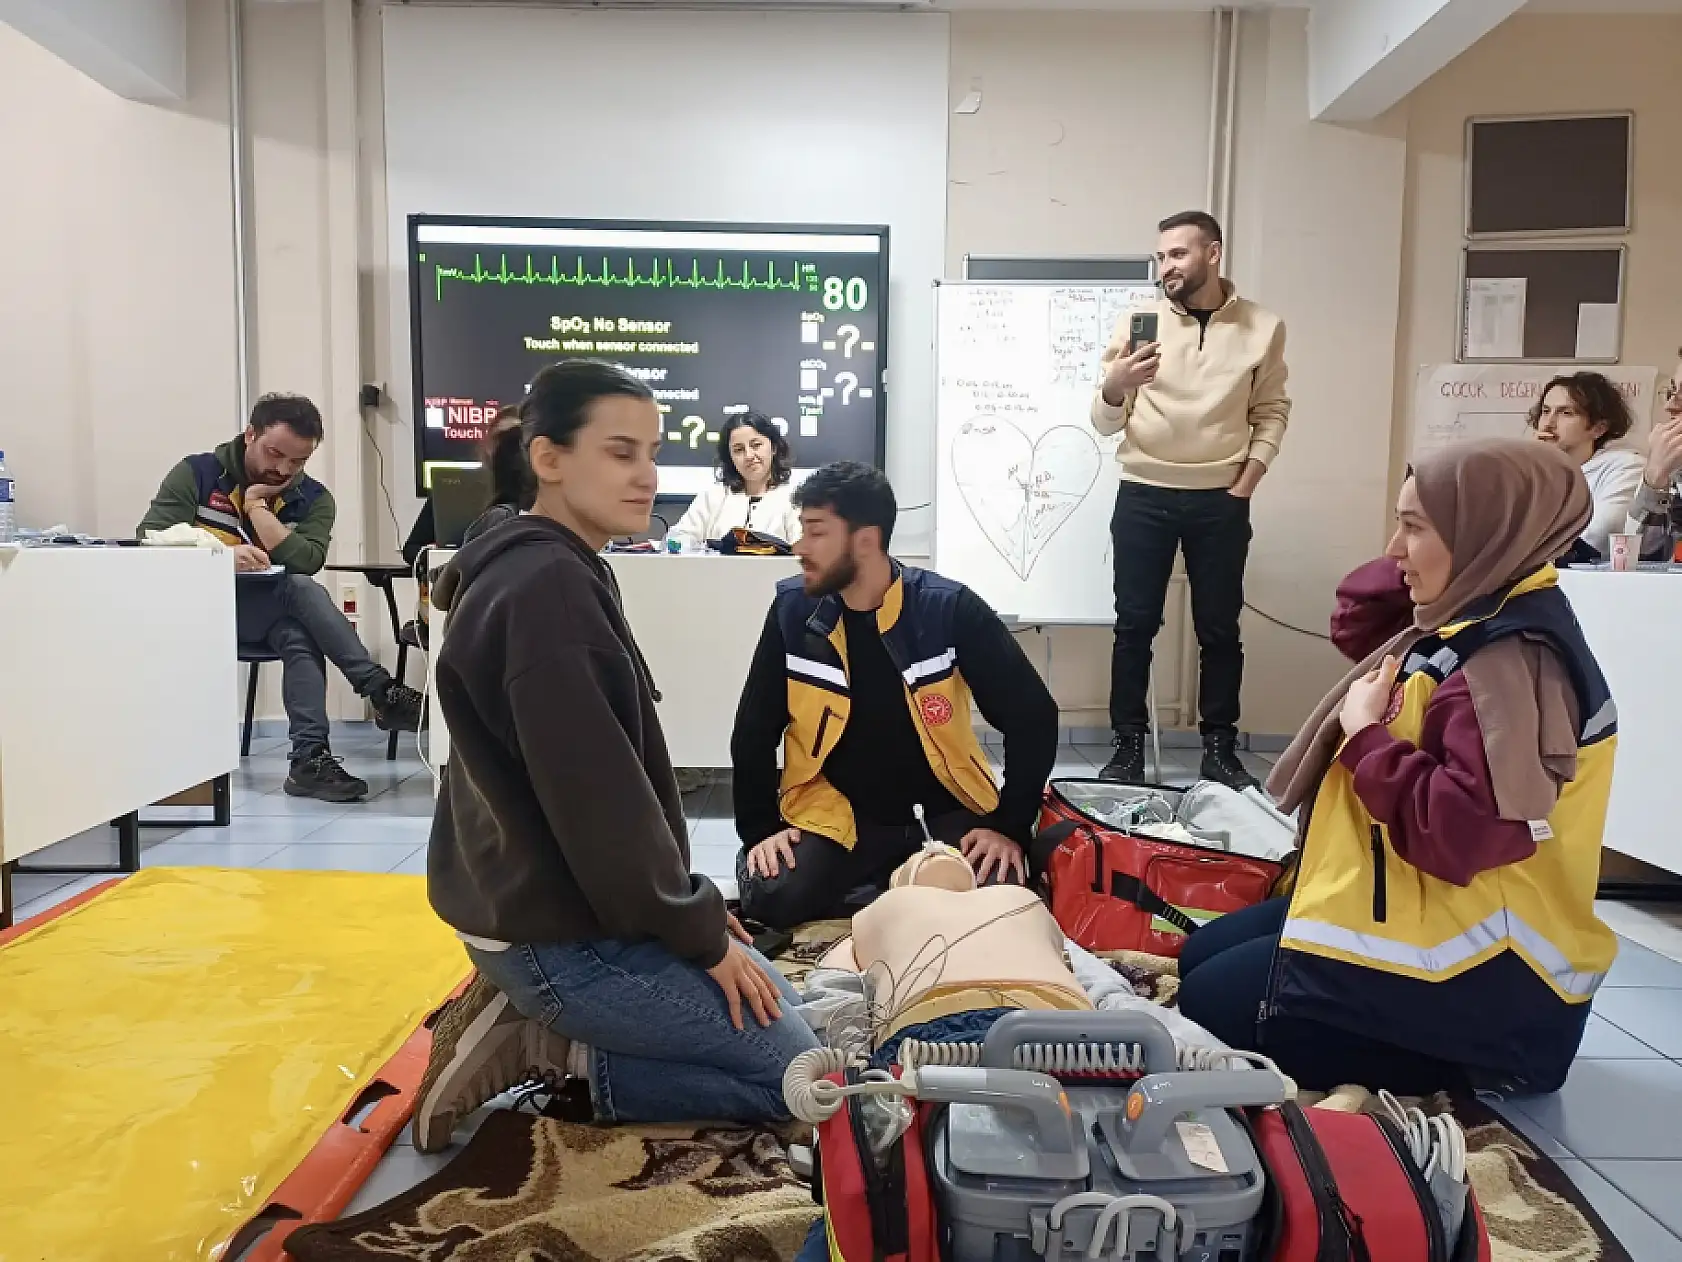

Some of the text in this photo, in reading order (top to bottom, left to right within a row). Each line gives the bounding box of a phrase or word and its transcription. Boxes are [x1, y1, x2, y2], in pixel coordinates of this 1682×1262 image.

[822, 276, 868, 311] 80
[593, 317, 615, 332] No
[617, 317, 672, 334] Sensor
[524, 336, 699, 353] Touch when sensor connected
[619, 364, 668, 381] ensor
[448, 406, 498, 424] NIBP
[442, 426, 483, 439] Touch
